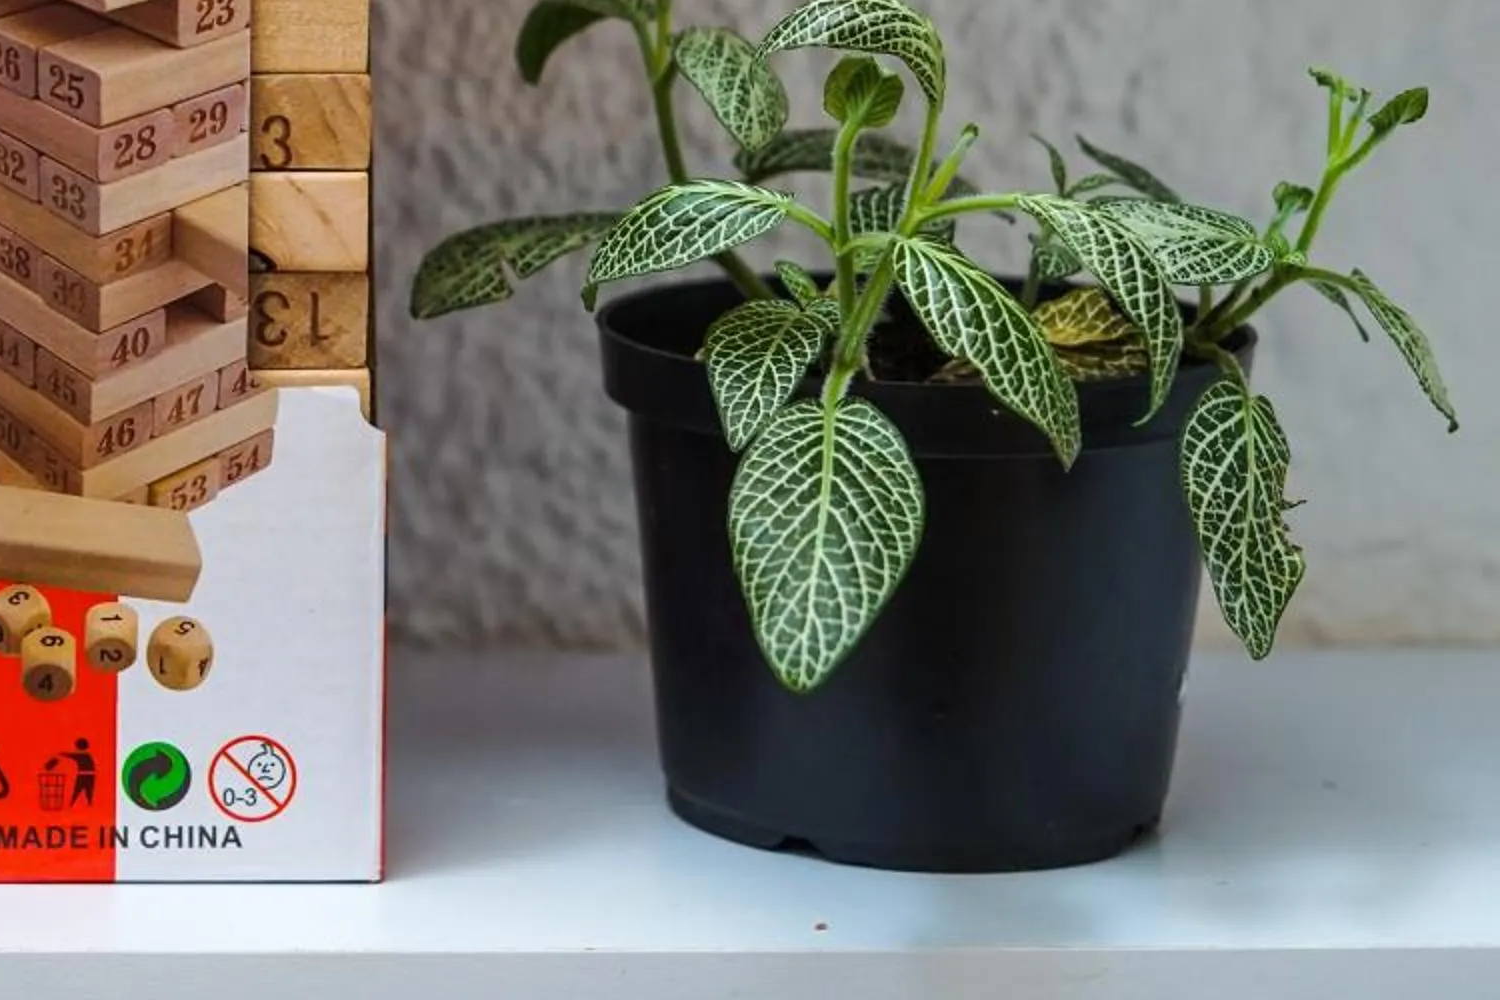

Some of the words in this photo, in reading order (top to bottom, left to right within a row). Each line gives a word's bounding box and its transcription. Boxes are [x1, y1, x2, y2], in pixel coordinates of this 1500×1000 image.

[49, 65, 84, 109] 25
[114, 126, 157, 168] 28
[189, 102, 229, 142] 29
[52, 175, 87, 220] 33
[0, 237, 31, 279] 38
[115, 229, 154, 272] 34
[255, 291, 330, 347] 13
[112, 327, 150, 366] 40
[96, 417, 135, 456] 46
[167, 383, 204, 424] 47
[171, 475, 208, 511] 53
[227, 445, 260, 481] 54
[37, 674, 54, 692] 4
[224, 788, 259, 807] 0-3
[99, 826, 129, 849] IN
[139, 825, 243, 849] CHINA
